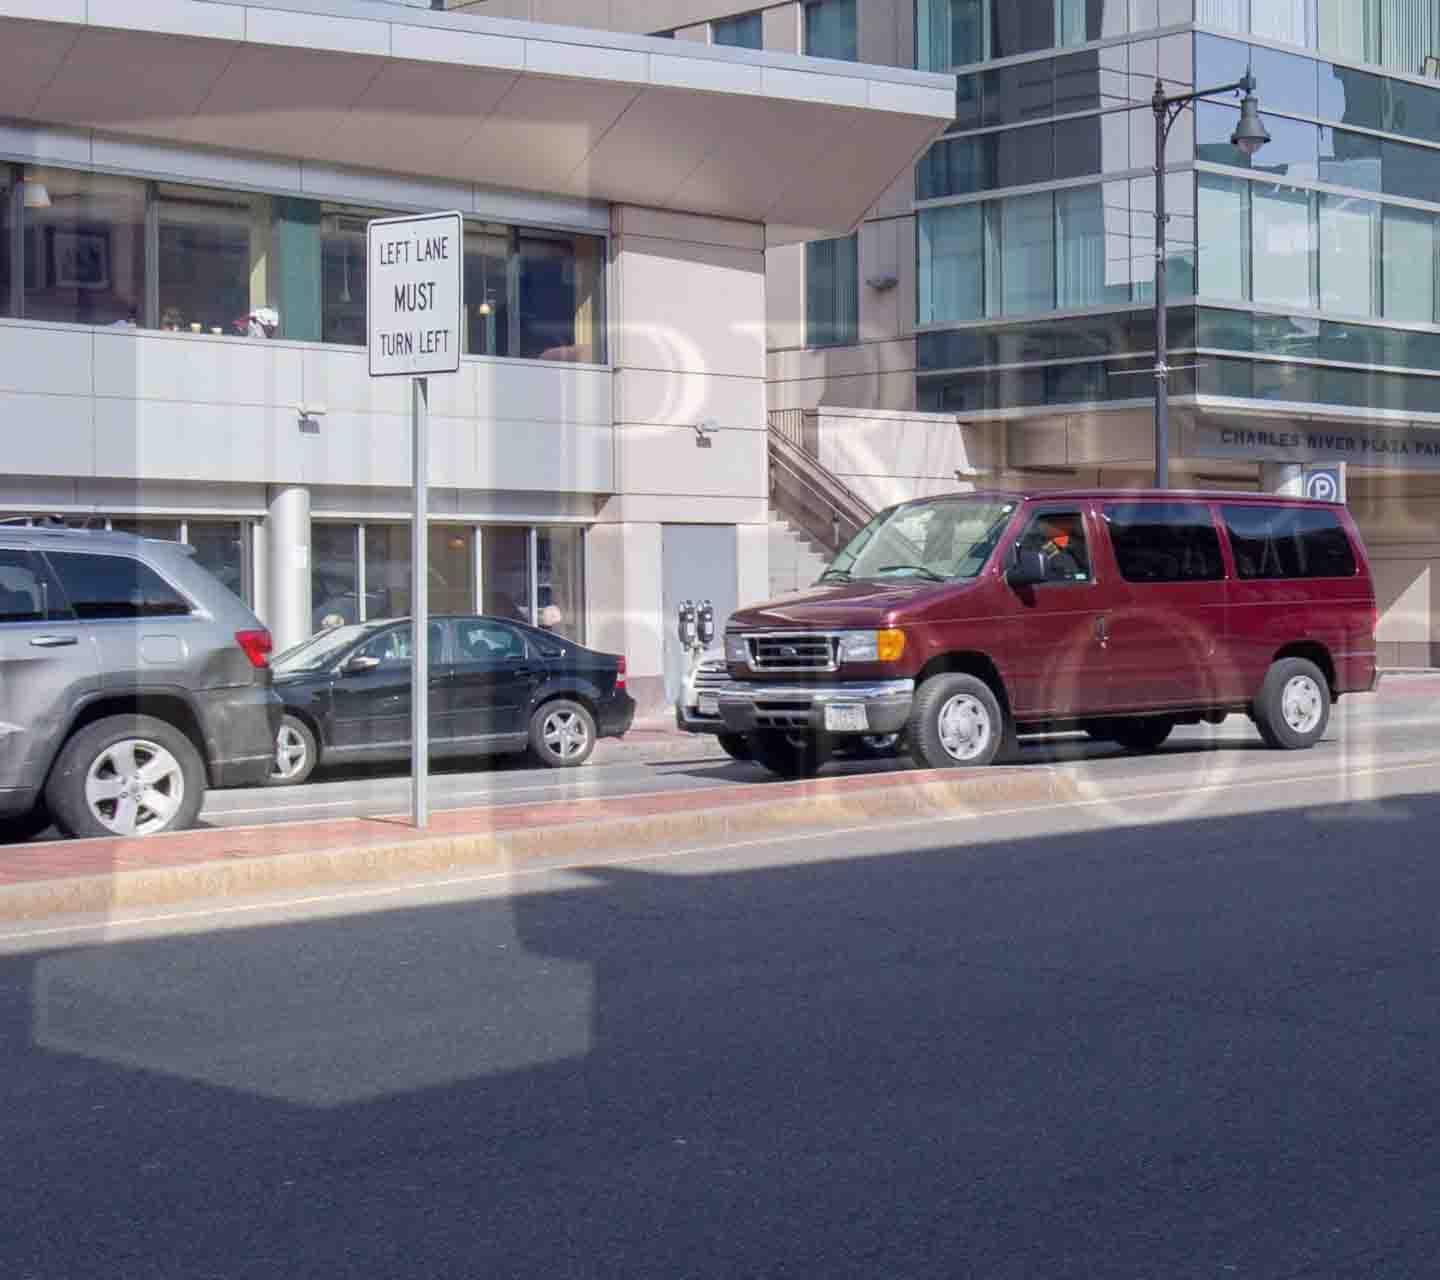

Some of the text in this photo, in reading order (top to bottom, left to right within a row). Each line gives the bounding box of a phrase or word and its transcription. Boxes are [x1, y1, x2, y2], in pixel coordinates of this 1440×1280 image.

[380, 236, 449, 265] LEFT LANE
[394, 281, 436, 312] MUST
[380, 330, 449, 356] TURN LEFT
[1220, 431, 1299, 447] CHARLES
[1306, 434, 1355, 451] RIVER
[1362, 438, 1409, 454] PLAZA
